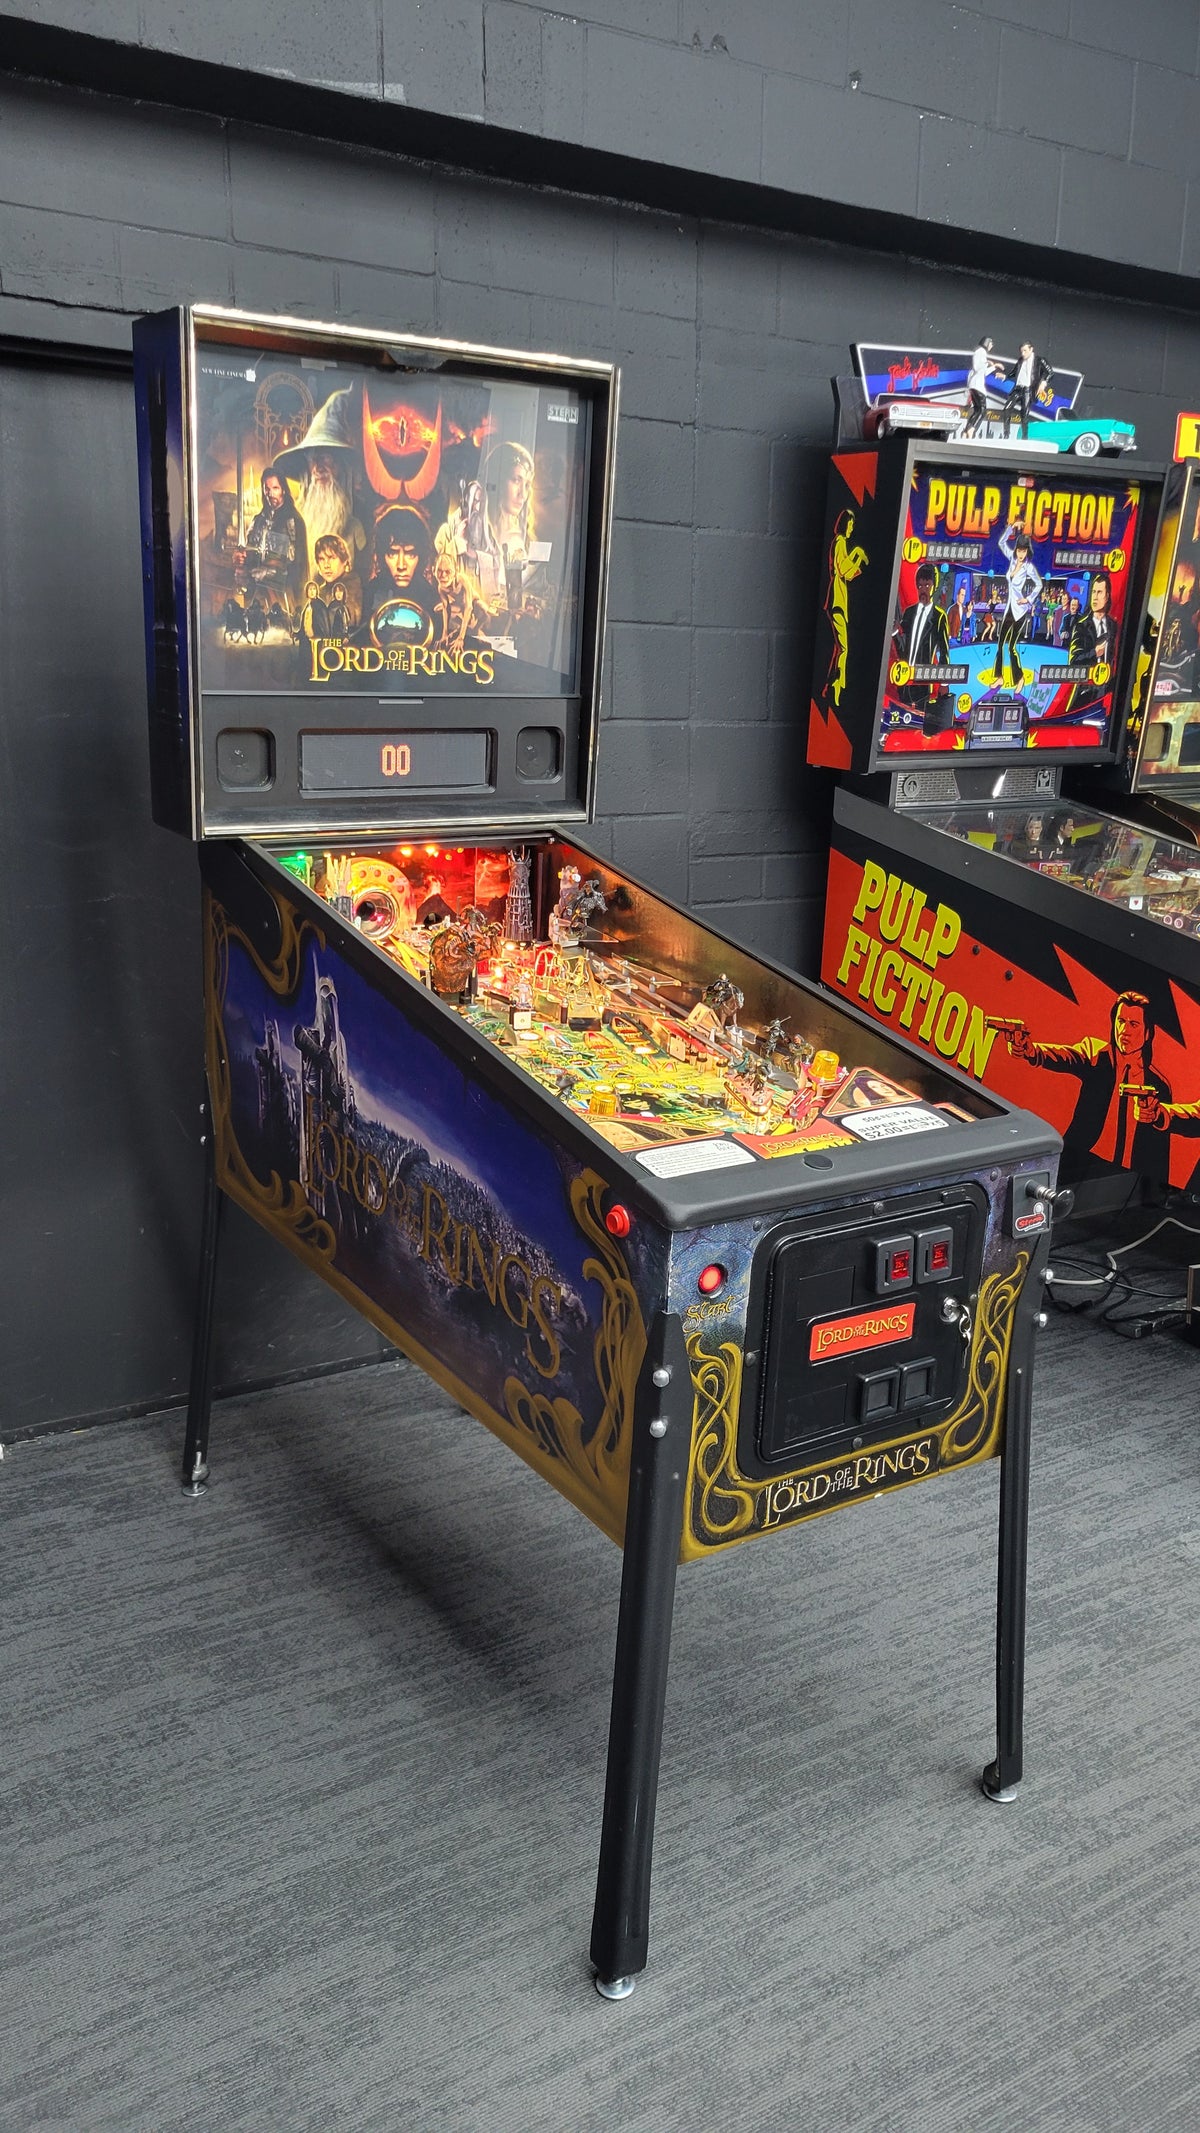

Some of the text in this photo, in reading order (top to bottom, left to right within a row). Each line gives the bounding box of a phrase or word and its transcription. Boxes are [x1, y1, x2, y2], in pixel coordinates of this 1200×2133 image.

[925, 477, 1115, 544] PULP FICTION
[309, 638, 494, 684] THE LORD OF THE RINGS
[381, 744, 411, 776] 00
[851, 859, 962, 970] PULP
[836, 924, 999, 1080] FICTION
[858, 1116, 936, 1134] SUPER VALUE
[304, 1093, 388, 1216] LORD
[420, 1181, 562, 1379] RINGS
[816, 1326, 854, 1353] LORD
[864, 1313, 909, 1338] RINGS
[761, 1439, 932, 1529] THE LORD OF THE RINGS
